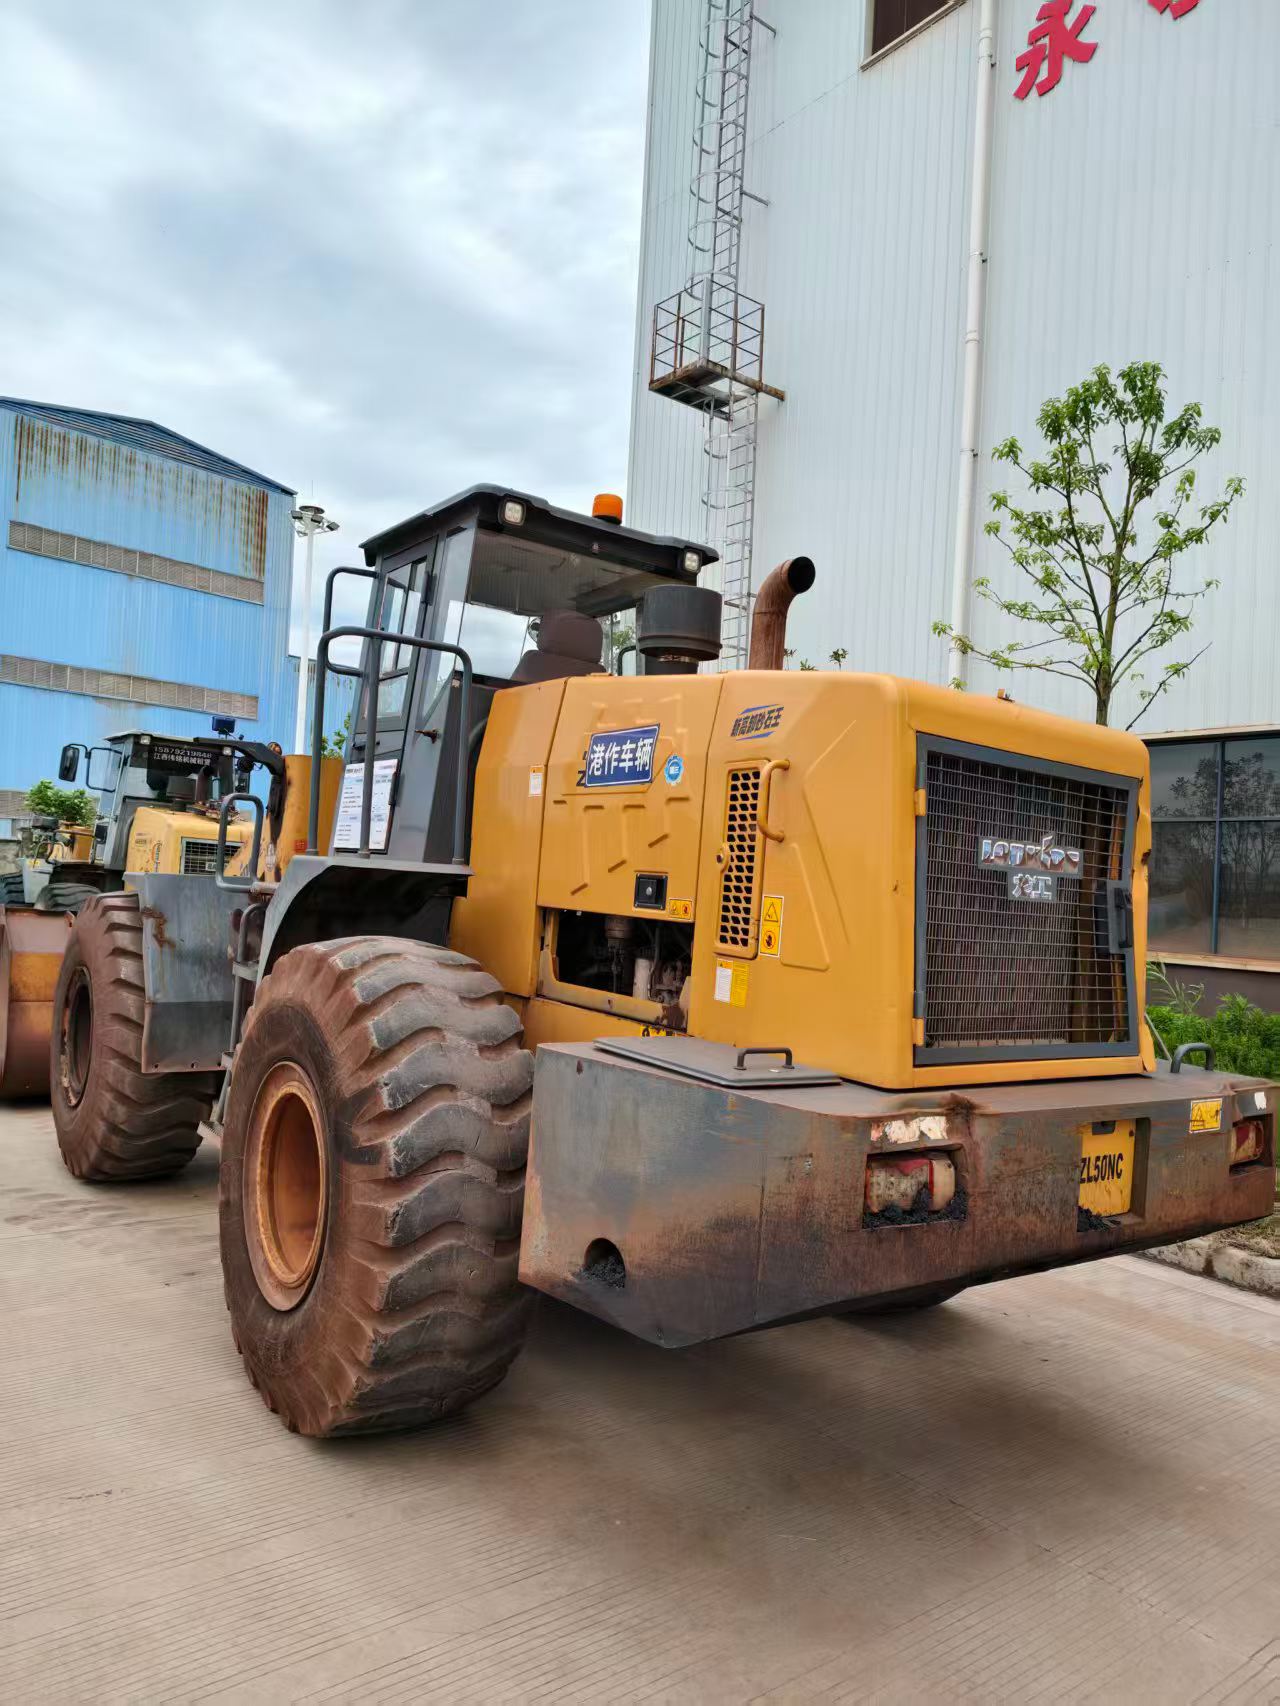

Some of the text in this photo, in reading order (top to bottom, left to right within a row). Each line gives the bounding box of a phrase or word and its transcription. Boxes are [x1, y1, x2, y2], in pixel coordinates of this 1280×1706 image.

[589, 737, 654, 776] 港作车辆
[1012, 873, 1052, 900] 龙工
[1079, 1152, 1124, 1184] ZL50NC
